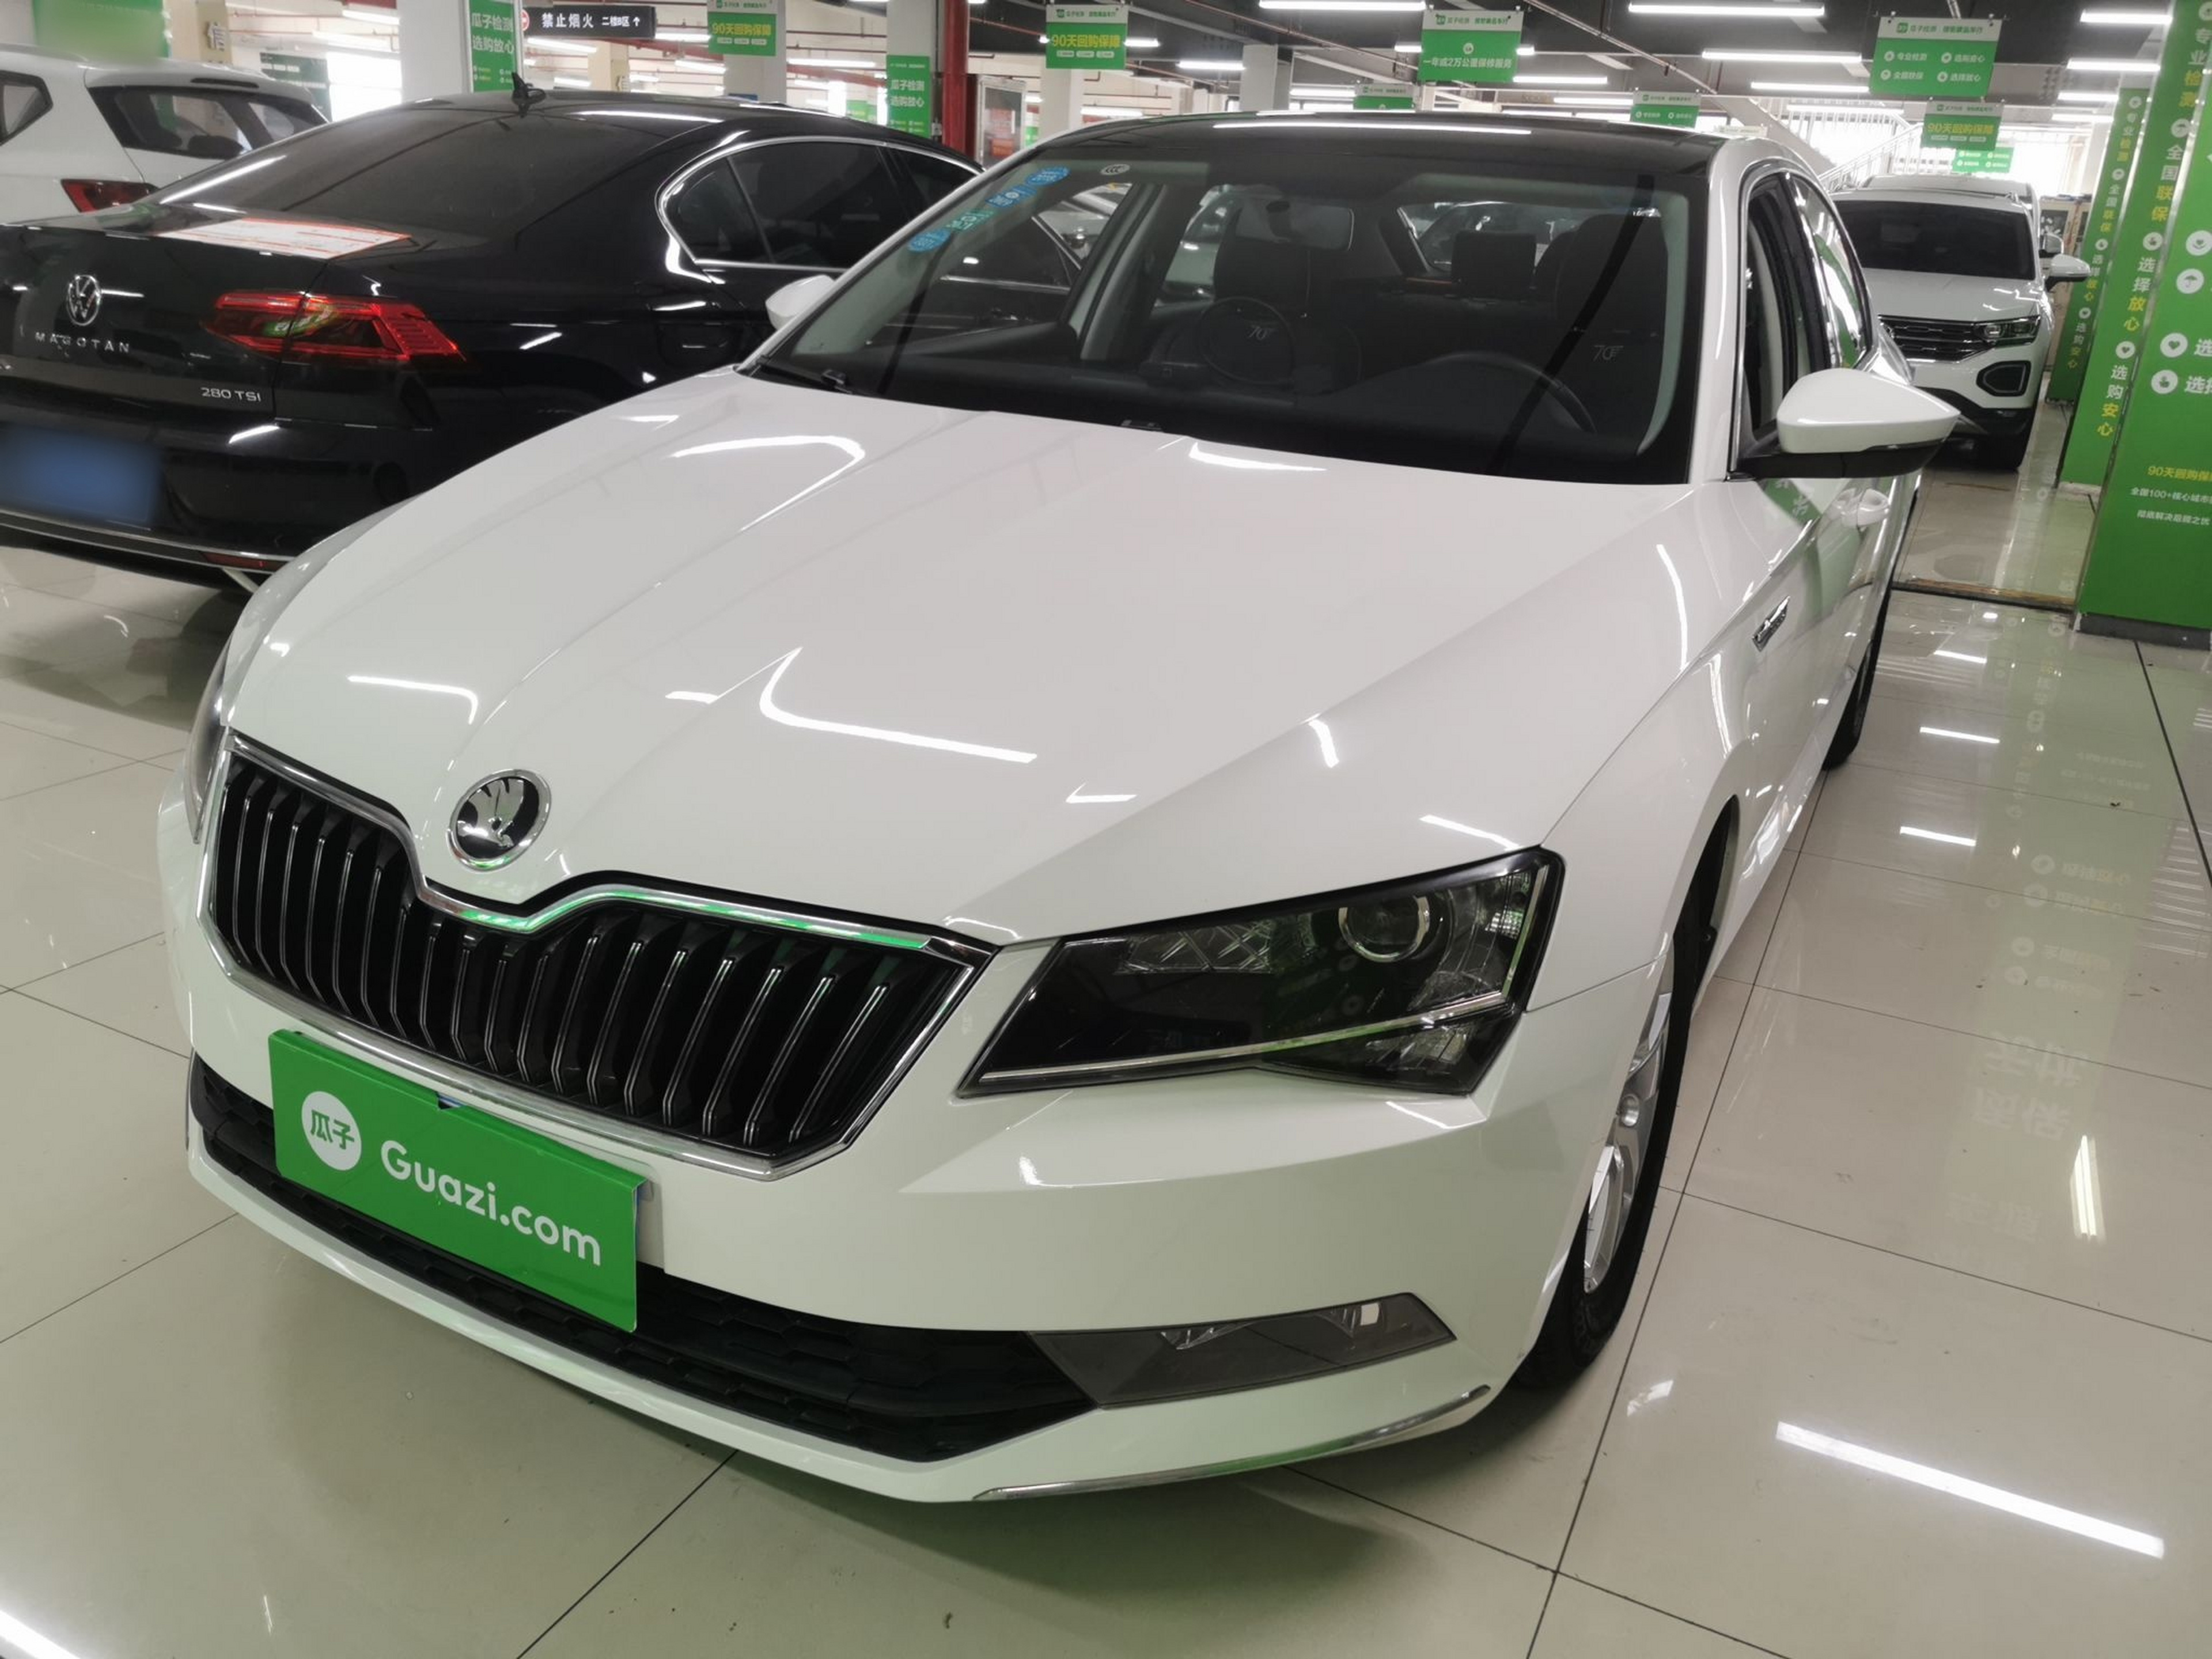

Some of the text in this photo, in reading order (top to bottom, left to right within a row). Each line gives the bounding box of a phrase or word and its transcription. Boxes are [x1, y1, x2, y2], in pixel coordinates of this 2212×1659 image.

[542, 12, 594, 28] 禁止烟火
[1052, 35, 1120, 48] 90天回购保障
[2151, 144, 2183, 222] 全国联保
[2123, 256, 2157, 332] 选择放心
[35, 332, 130, 354] MAGOTAN
[201, 387, 261, 403] 280 TSI
[2097, 365, 2128, 437] 选购安心
[2147, 465, 2212, 482] 90天回购保
[2131, 487, 2212, 505] 全国100+核心城市
[310, 1109, 355, 1150] 瓜子
[381, 1140, 601, 1266] Guazi.com
